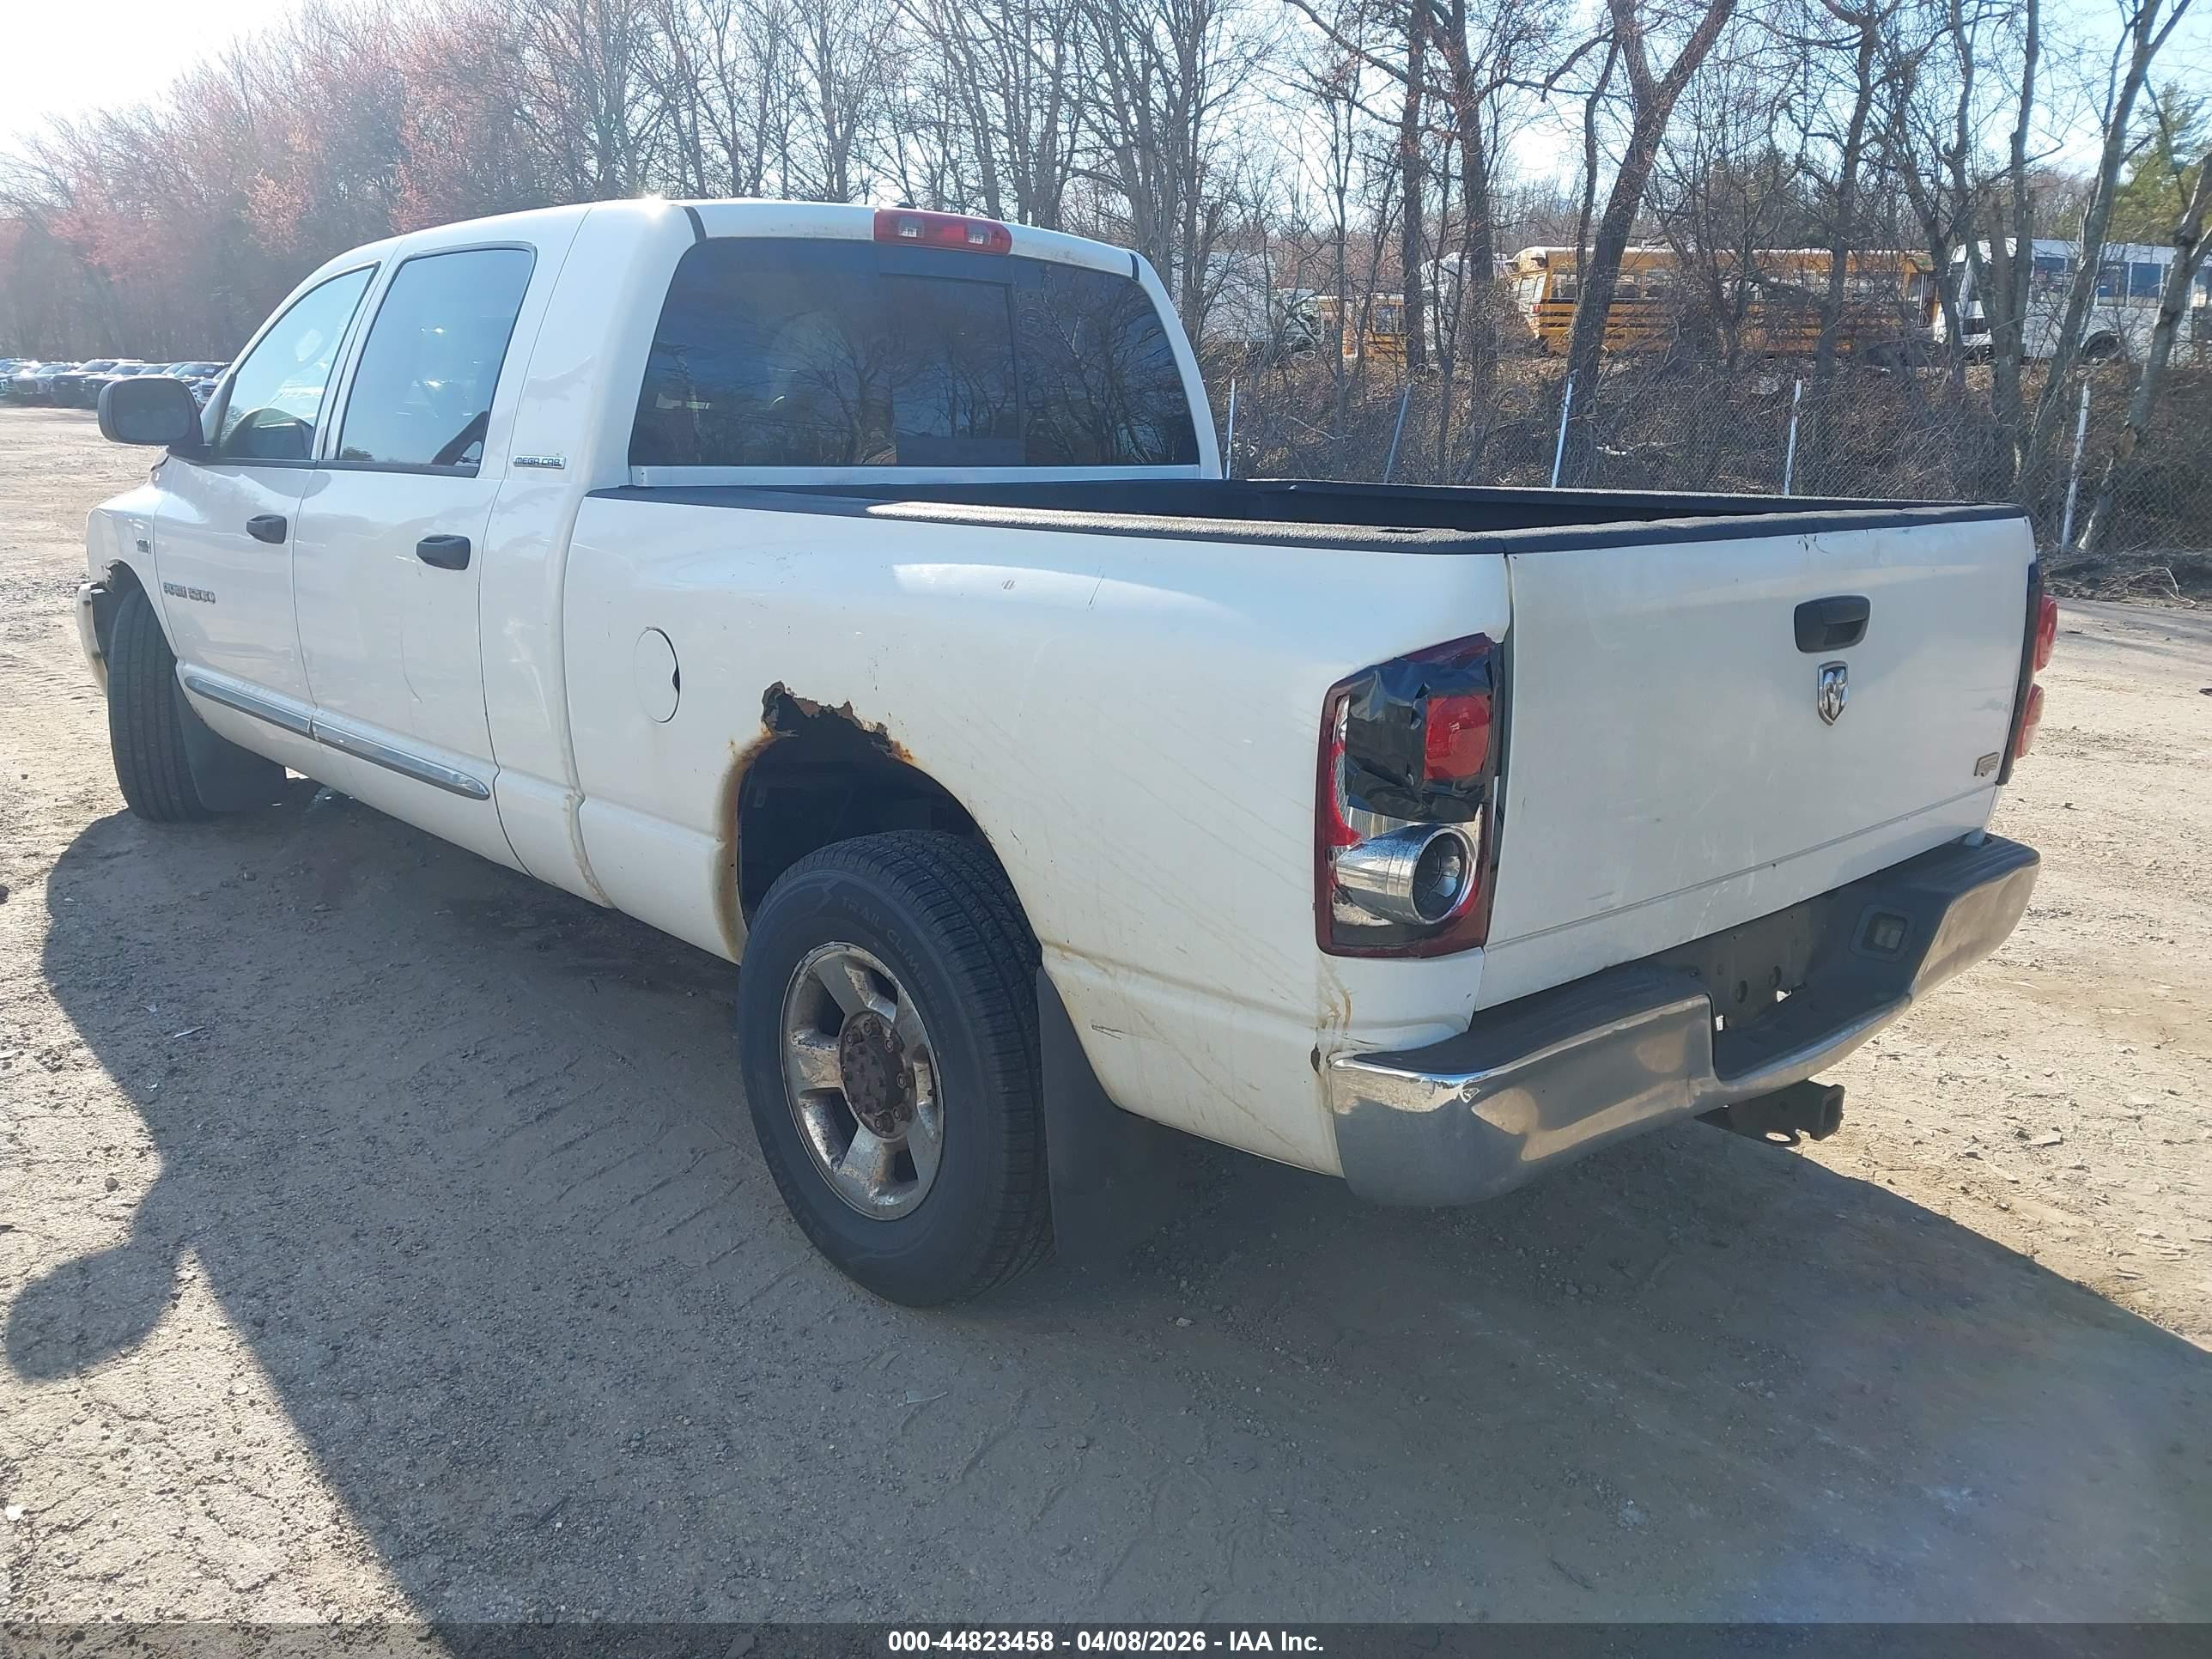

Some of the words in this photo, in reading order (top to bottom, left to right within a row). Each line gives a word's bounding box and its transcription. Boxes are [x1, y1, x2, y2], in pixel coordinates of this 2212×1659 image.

[515, 456, 540, 466] MEGA
[541, 458, 562, 467] CAB
[842, 896, 881, 929] TRAIL
